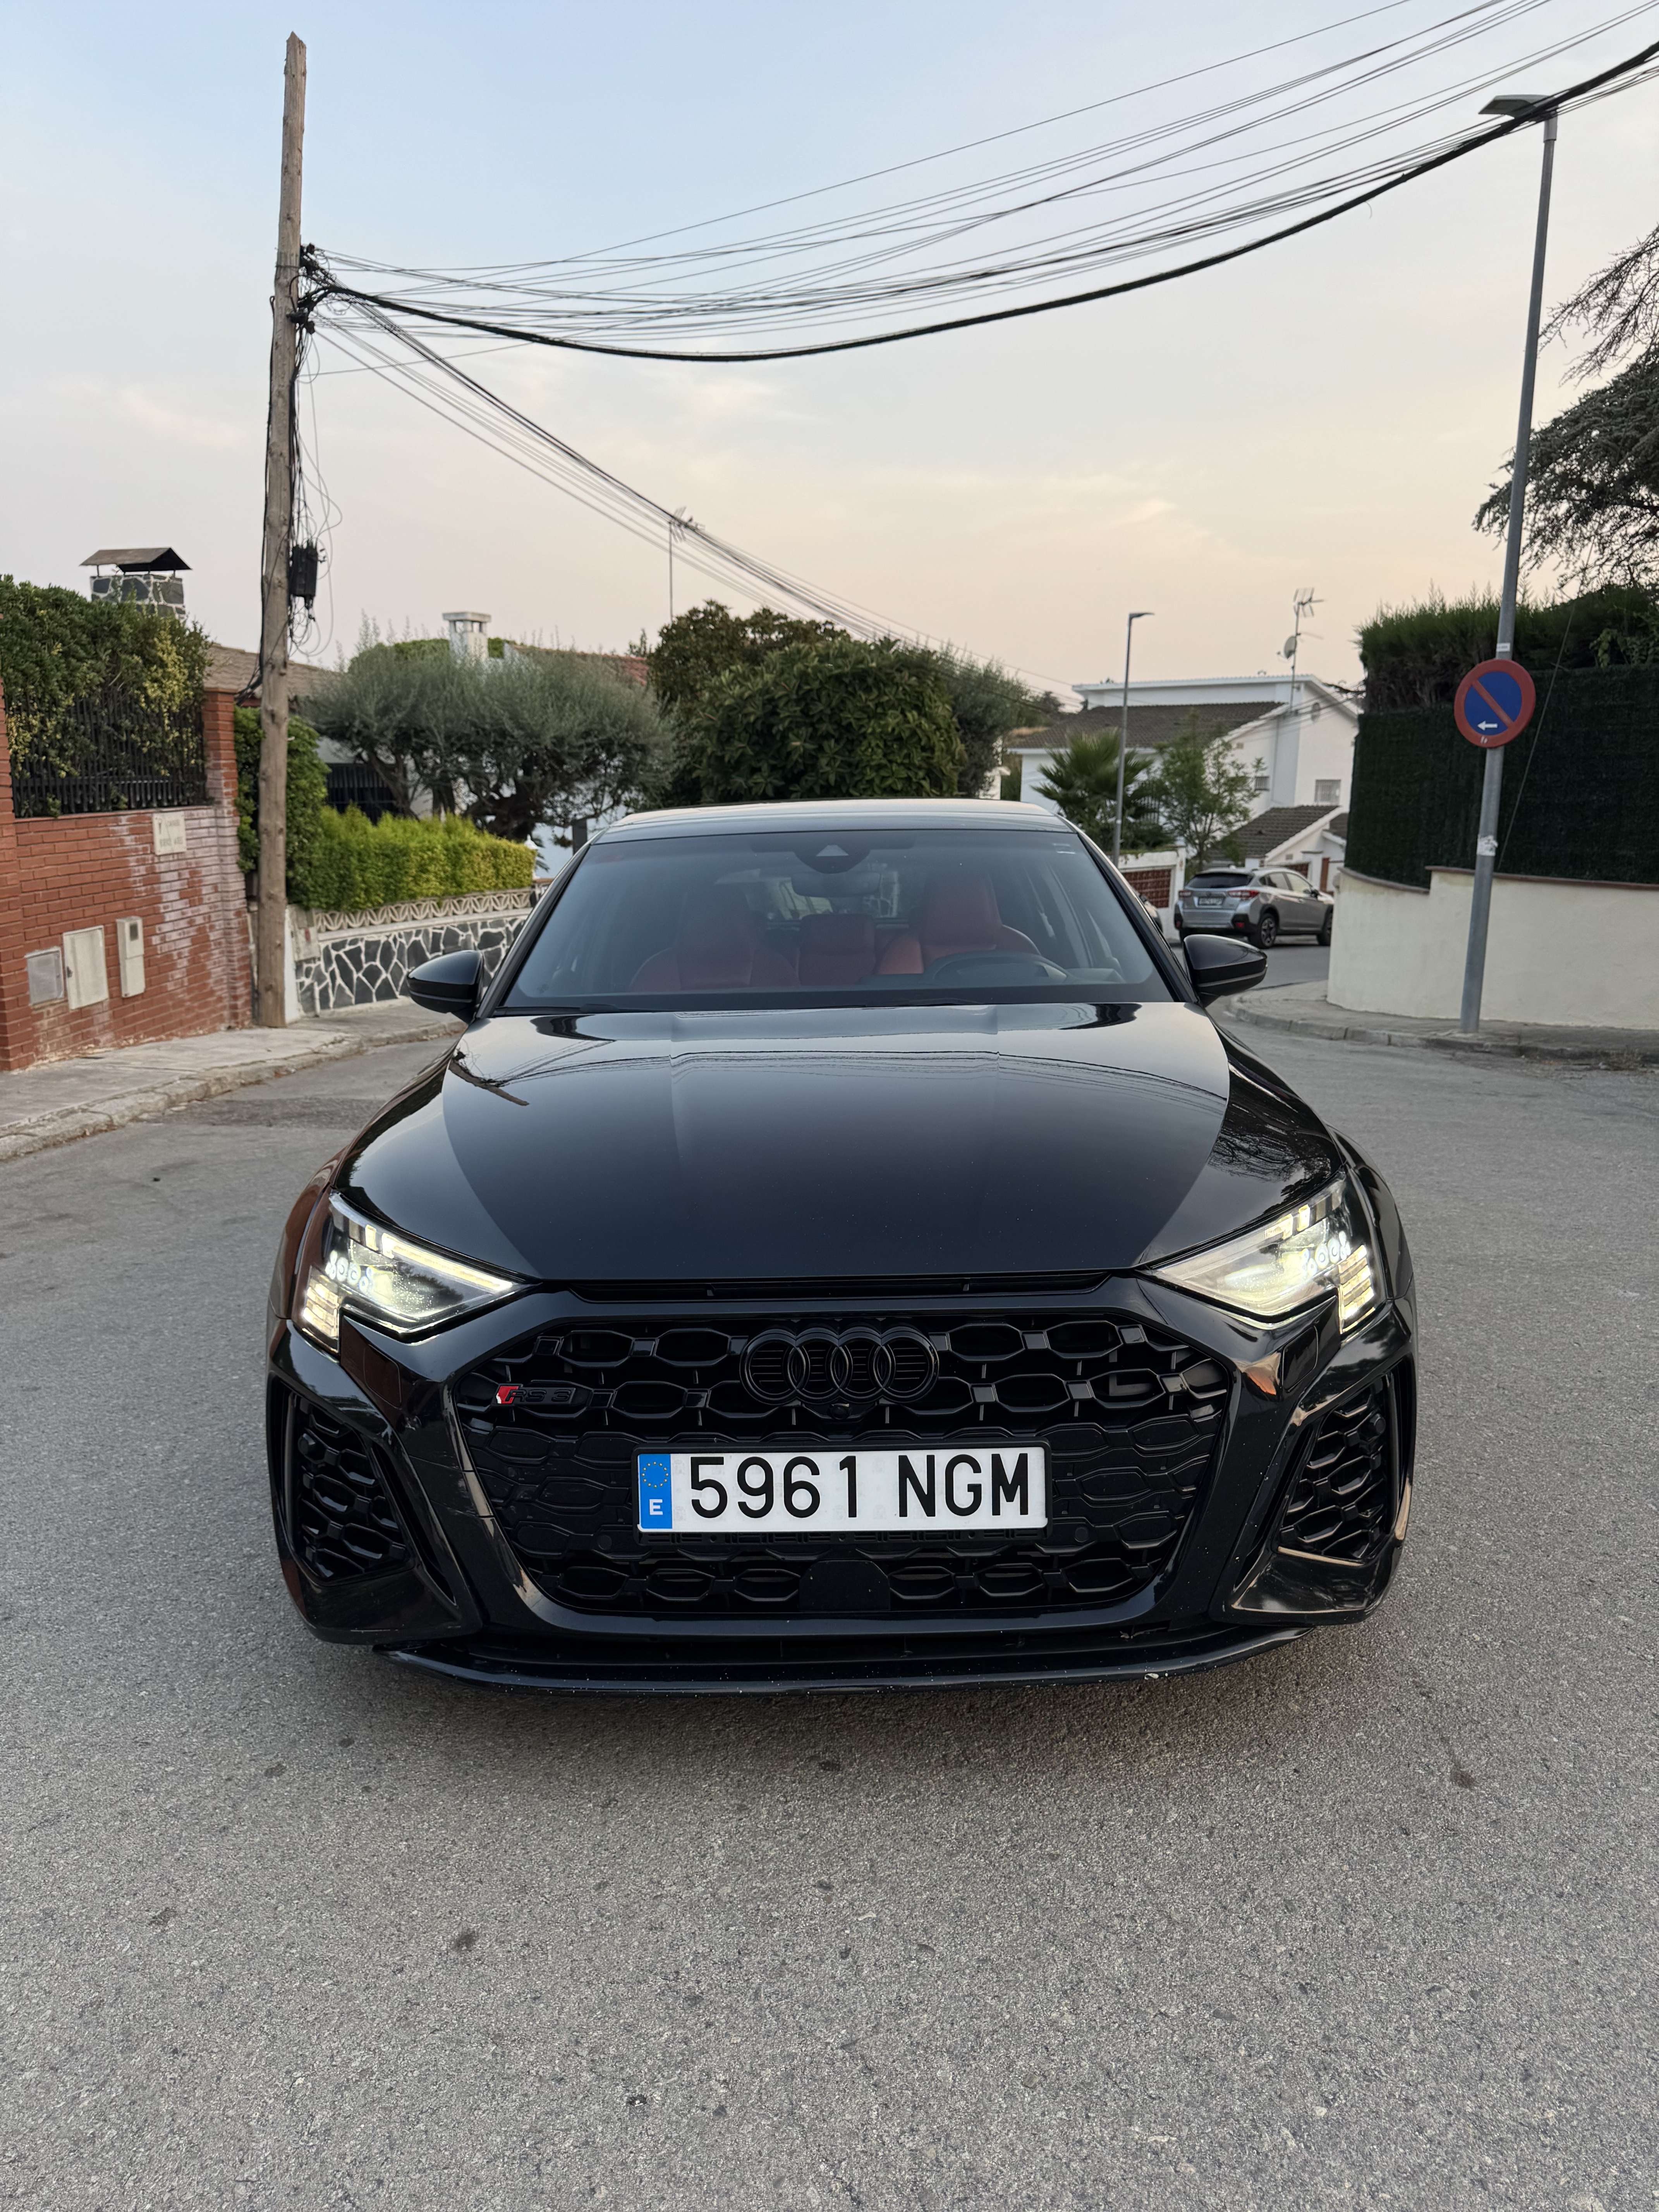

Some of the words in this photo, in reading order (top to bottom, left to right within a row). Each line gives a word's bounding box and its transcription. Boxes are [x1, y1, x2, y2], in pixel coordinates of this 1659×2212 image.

[505, 1389, 546, 1402] RS
[551, 1389, 572, 1402] 3
[649, 1499, 663, 1515] E
[690, 1455, 857, 1518] 5961
[898, 1454, 1029, 1517] NGM
